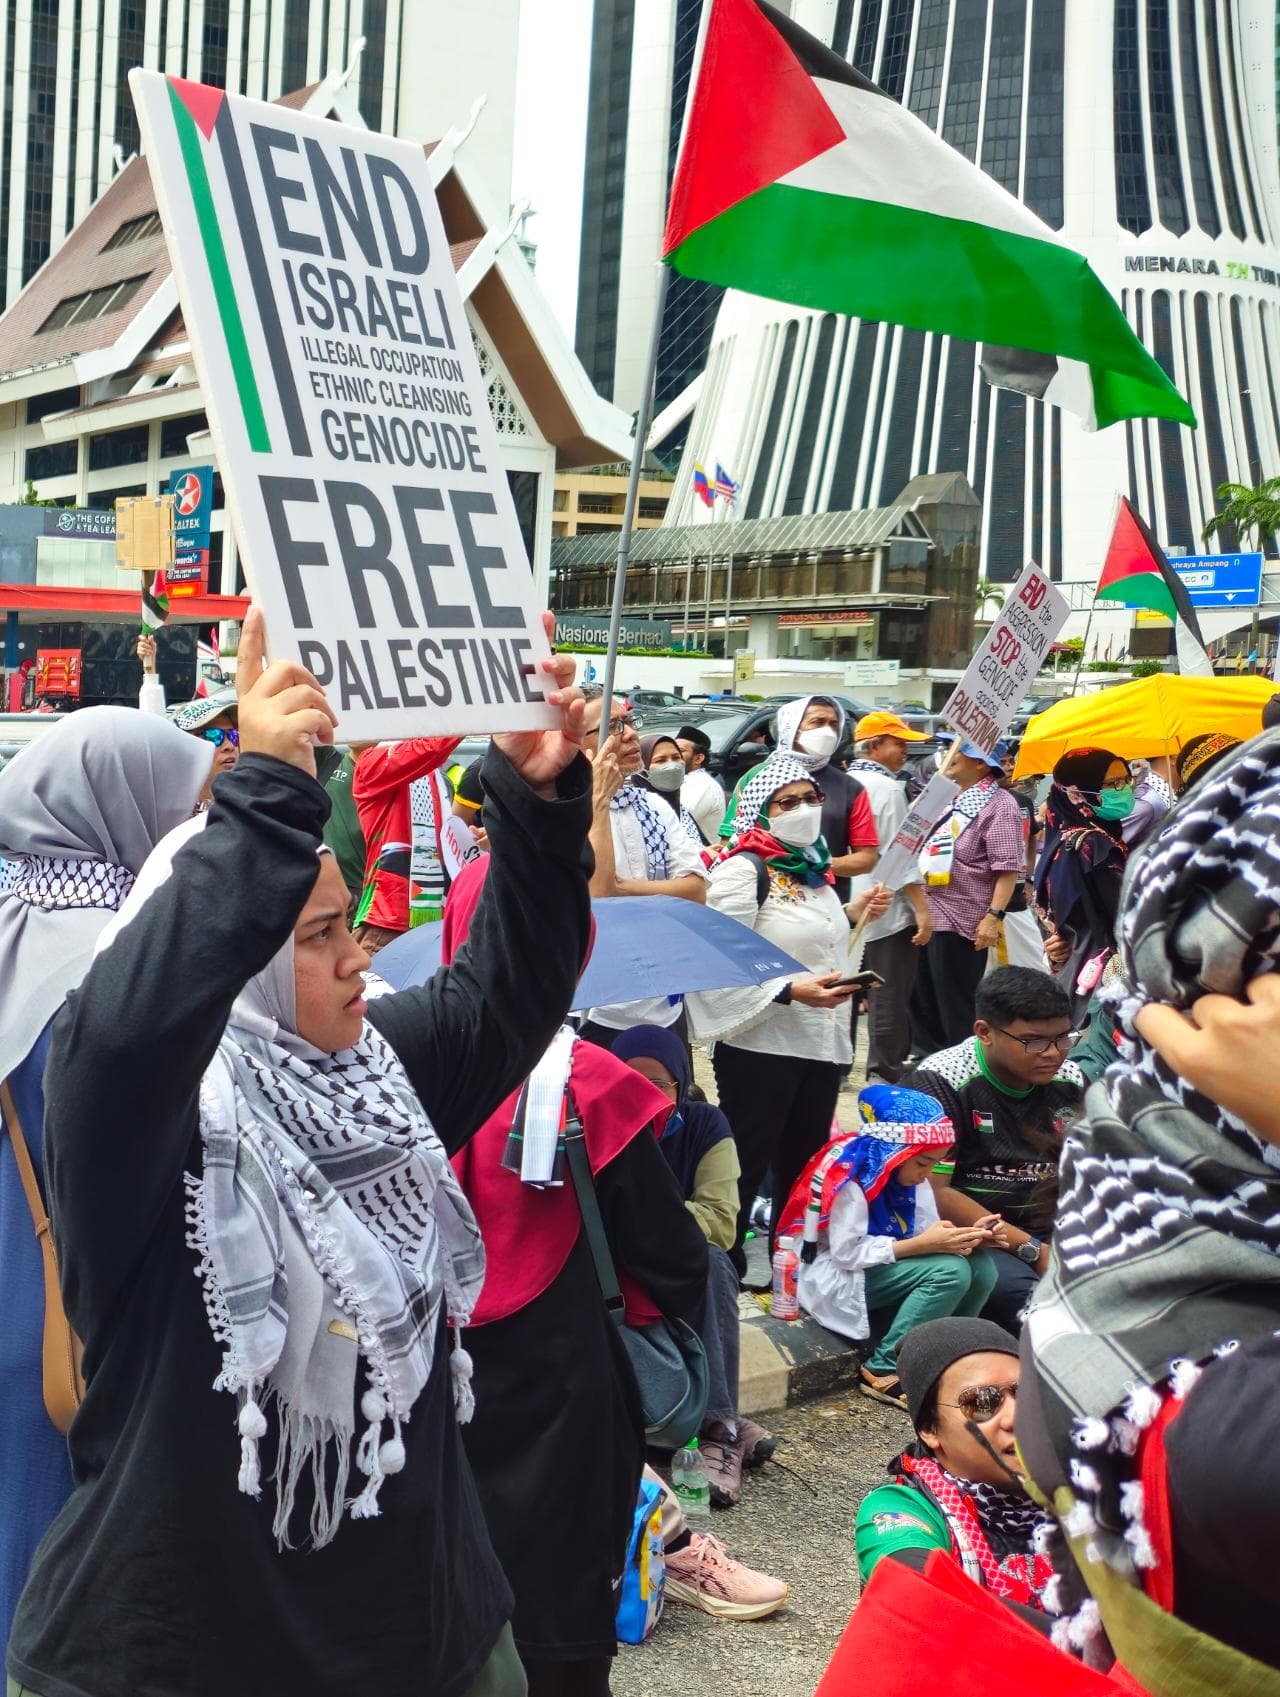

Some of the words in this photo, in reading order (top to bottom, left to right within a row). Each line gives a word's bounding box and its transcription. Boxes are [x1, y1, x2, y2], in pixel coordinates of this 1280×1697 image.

[250, 122, 429, 275] END
[1125, 256, 1220, 275] MENARA
[282, 259, 456, 350] ISRAELI
[300, 336, 369, 369] ILLEGAL
[370, 346, 464, 383] OCCUPATION
[309, 371, 376, 404] ETHNIC
[379, 380, 472, 416] CLEANSING
[321, 408, 487, 474] GENOCIDE
[76, 514, 91, 522] THE
[95, 515, 116, 524] COFF
[83, 525, 98, 533] TEA
[101, 526, 116, 534] LEA
[258, 475, 526, 629] FREE
[1198, 560, 1229, 568] Ampang
[1019, 573, 1047, 611] END
[1038, 600, 1053, 627] the
[555, 623, 610, 643] Nasiona
[616, 626, 664, 645] Berhad
[990, 625, 1021, 669] STOP
[1014, 653, 1029, 682] the
[1003, 601, 1049, 660] AGGRESSION
[297, 637, 547, 711] PALESTINE
[978, 655, 1019, 708] GENOCIDE
[445, 825, 466, 869] HOL
